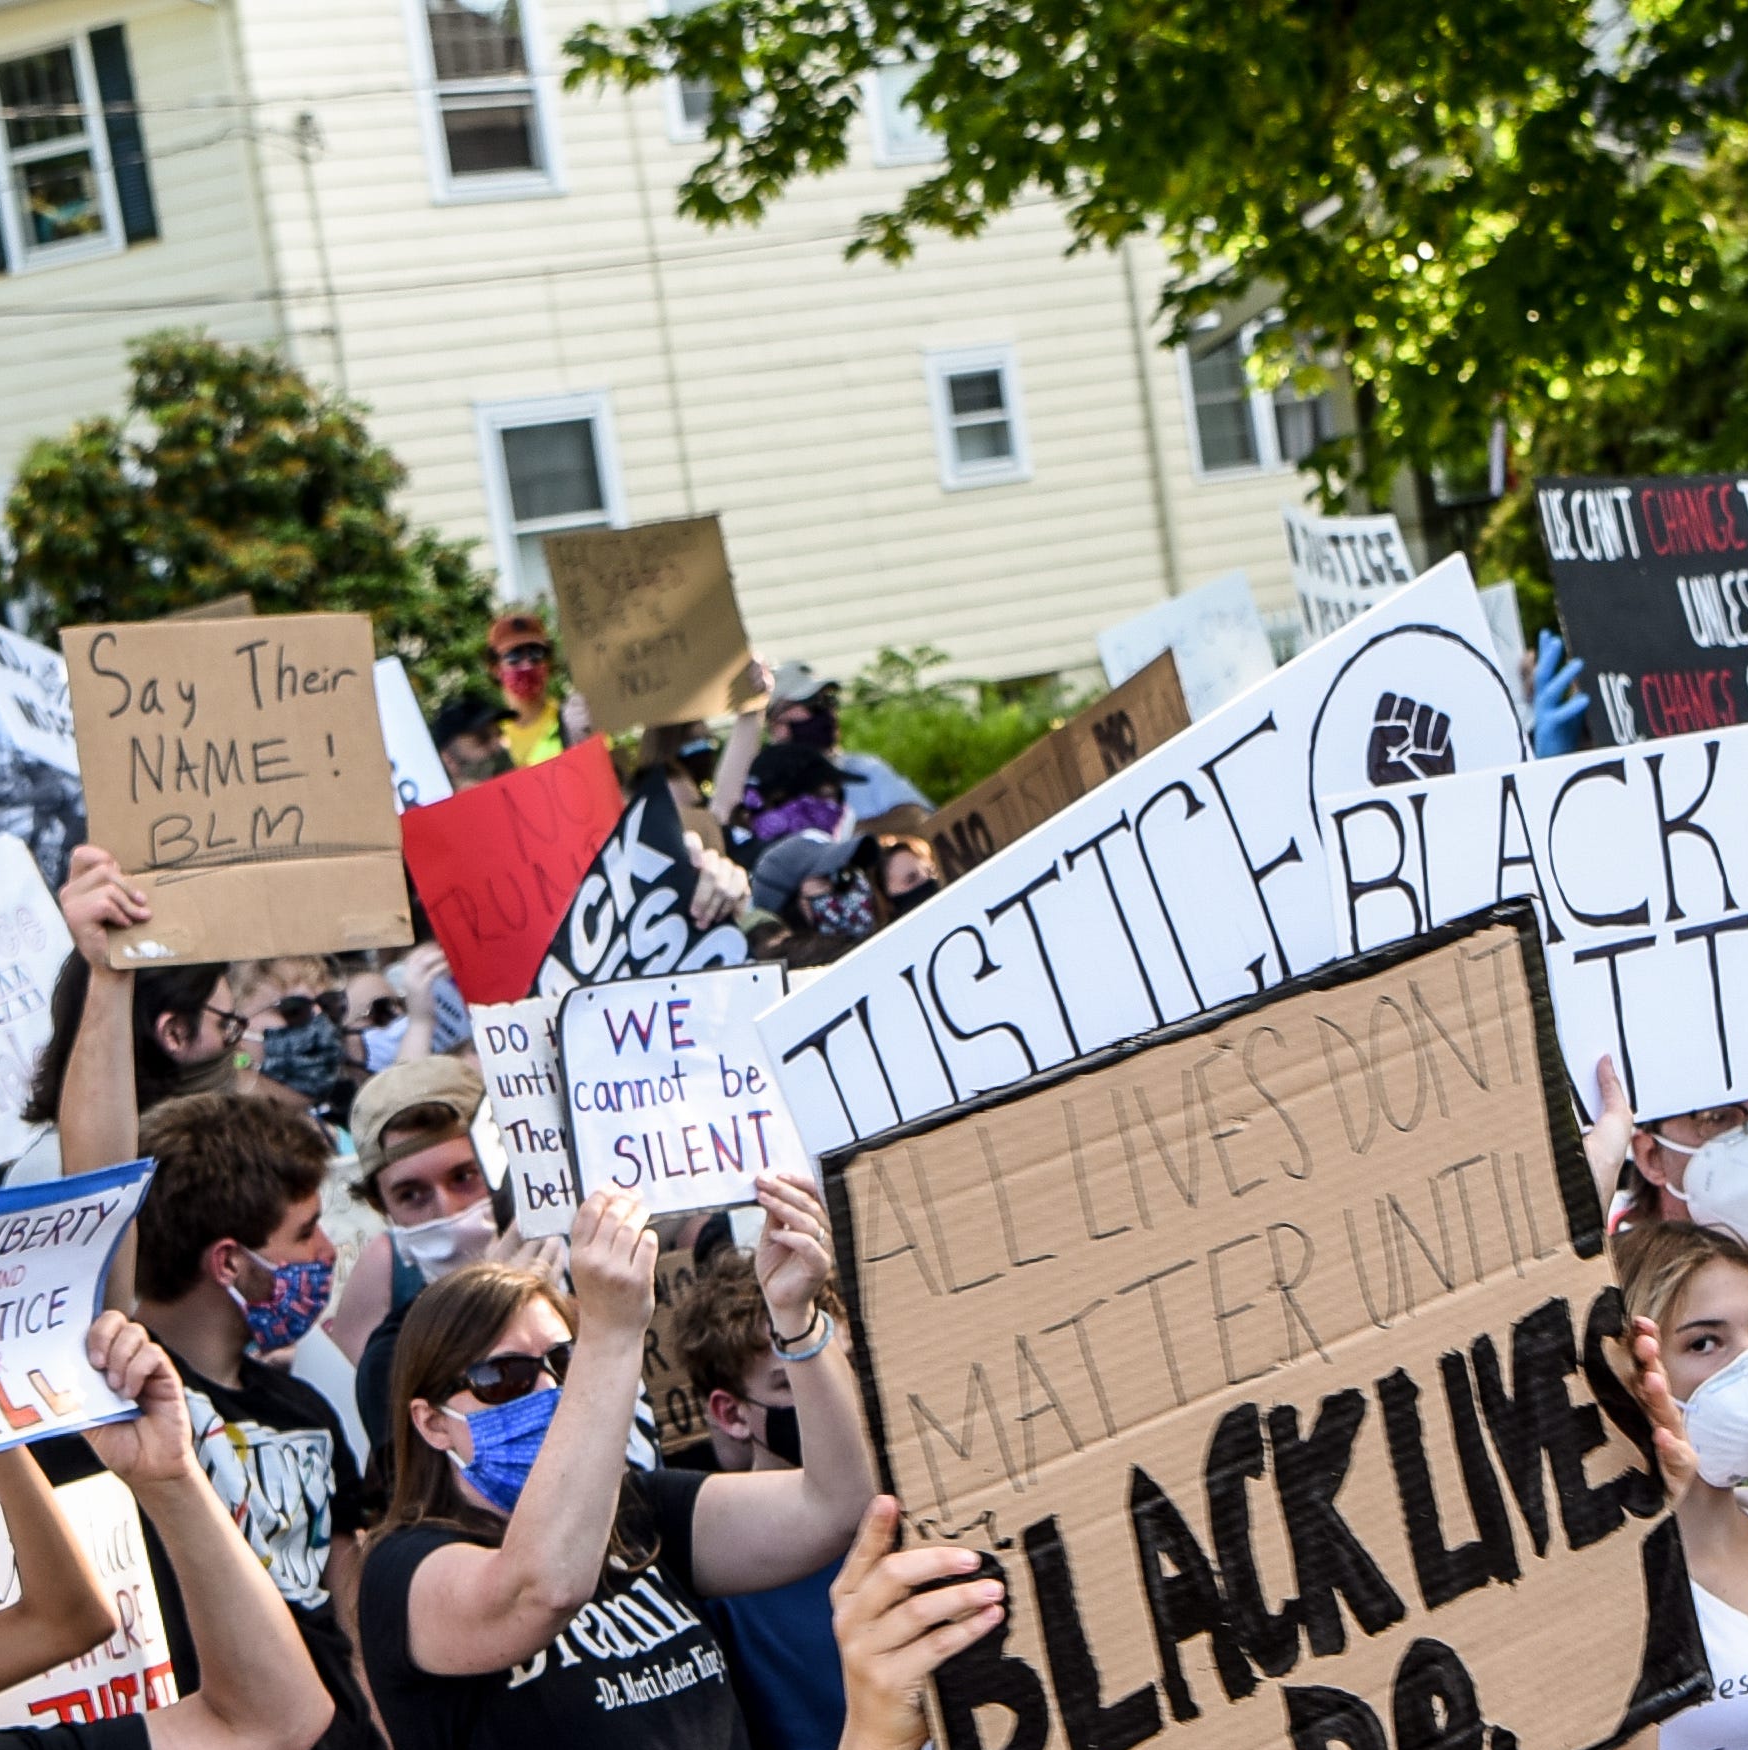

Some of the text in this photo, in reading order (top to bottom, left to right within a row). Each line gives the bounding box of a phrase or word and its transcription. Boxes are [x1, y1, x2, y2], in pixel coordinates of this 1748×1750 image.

[1537, 486, 1580, 561] WE
[1640, 481, 1748, 557] CHANGE
[88, 631, 198, 727] Say
[235, 639, 360, 713] Their
[144, 803, 305, 870] BLM
[1332, 739, 1741, 956] BLACK
[484, 1022, 530, 1057] DO
[603, 997, 697, 1056] WE
[496, 1054, 556, 1100] unti
[572, 1053, 768, 1115] cannot be
[611, 1107, 775, 1190] SILENT
[859, 1124, 1059, 1297] ALL
[1060, 1023, 1308, 1242] LIVES
[523, 1172, 575, 1212] bet
[905, 1220, 1335, 1522] MATTER
[1345, 1149, 1557, 1333] UNTIL
[1375, 1284, 1674, 1612] LIVES
